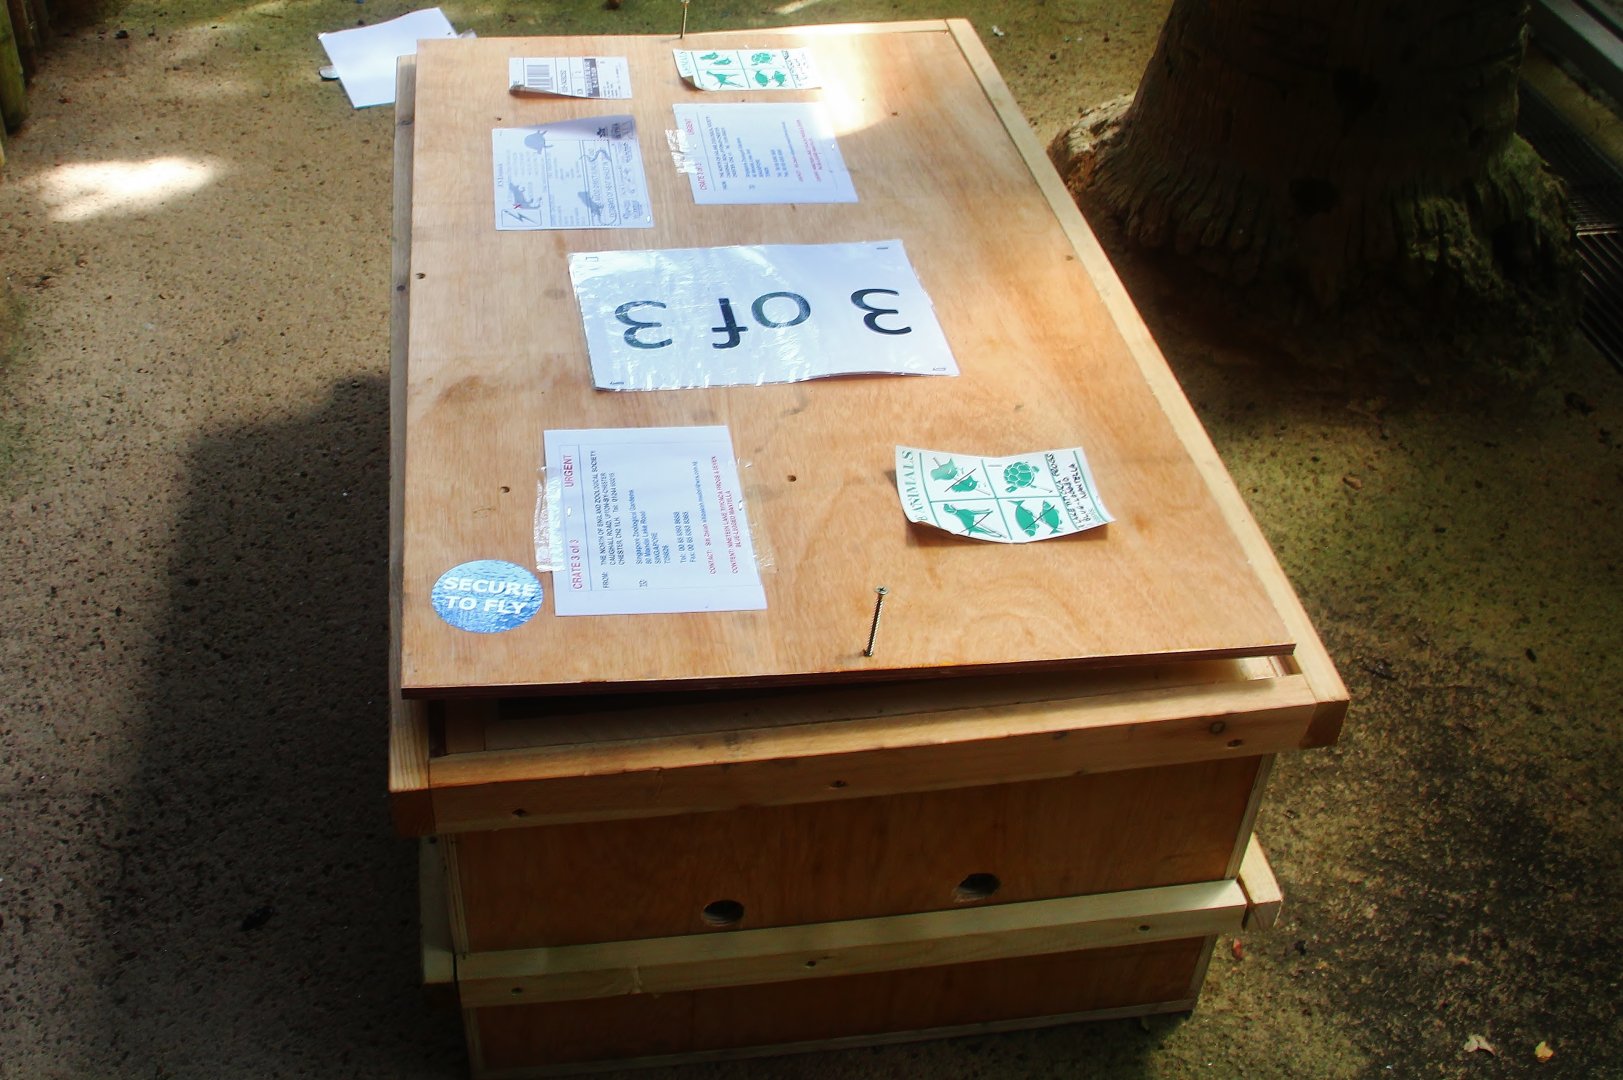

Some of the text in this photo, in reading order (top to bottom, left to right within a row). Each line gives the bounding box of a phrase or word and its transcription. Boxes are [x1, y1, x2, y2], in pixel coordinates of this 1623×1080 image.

[614, 288, 912, 349] 3 of 3
[562, 454, 574, 487] URGENT
[902, 451, 924, 512] ANIMALS
[592, 473, 600, 503] ZOOLOGICAL
[595, 504, 603, 526] ENGLAND
[569, 545, 579, 553] of
[598, 536, 606, 553] NORTH
[633, 537, 643, 564] Singapore
[650, 532, 661, 564] SINGAPORE
[443, 576, 536, 597] SECURE
[570, 562, 582, 589] CRATE
[445, 595, 528, 615] TO FLY
